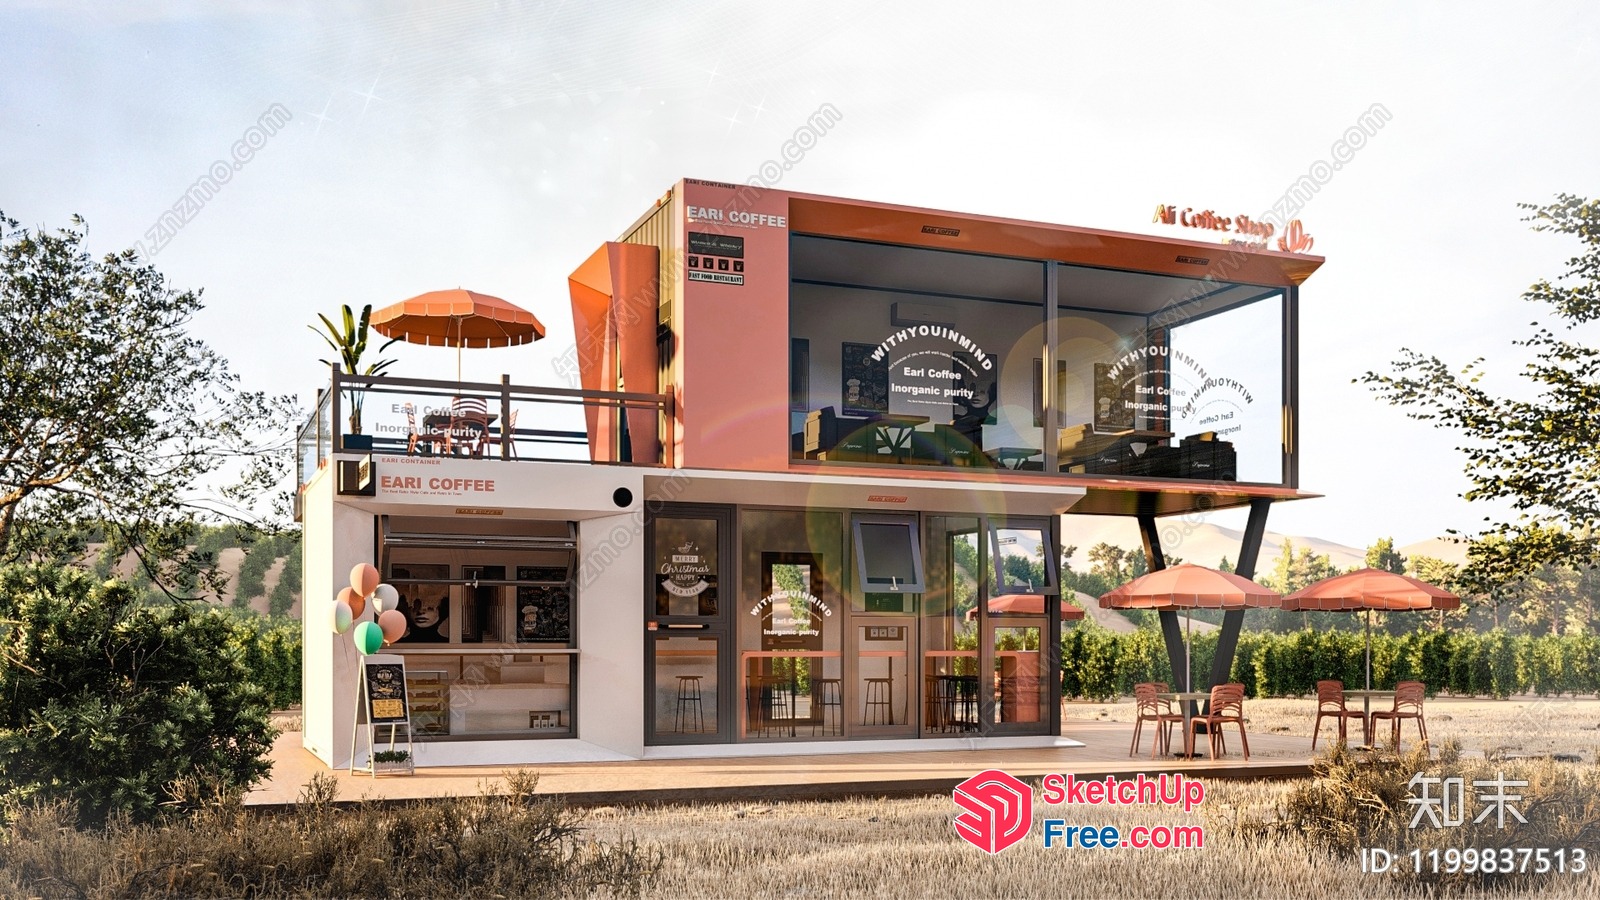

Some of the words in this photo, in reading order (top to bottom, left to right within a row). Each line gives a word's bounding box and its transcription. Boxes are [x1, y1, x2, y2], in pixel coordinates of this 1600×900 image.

[701, 180, 736, 190] CONTAINER
[687, 205, 724, 221] EARI
[728, 210, 787, 228] COFFEE
[1180, 207, 1232, 232] Coffee
[1234, 214, 1275, 239] Shop
[713, 274, 742, 283] RESTAURANT
[871, 324, 993, 371] WITHYOUINMIND
[903, 367, 925, 377] Earl
[928, 370, 962, 380] Coffee
[891, 383, 940, 395] Inorganic
[943, 388, 974, 400] purity
[1135, 384, 1154, 395] Earl
[1157, 386, 1187, 397] Coffee
[423, 405, 467, 418] Coffee
[1125, 400, 1168, 412] Inorganic
[443, 427, 482, 440] purity
[381, 475, 422, 489] EARI
[428, 477, 495, 492] COFFEE
[661, 562, 710, 575] Christmas
